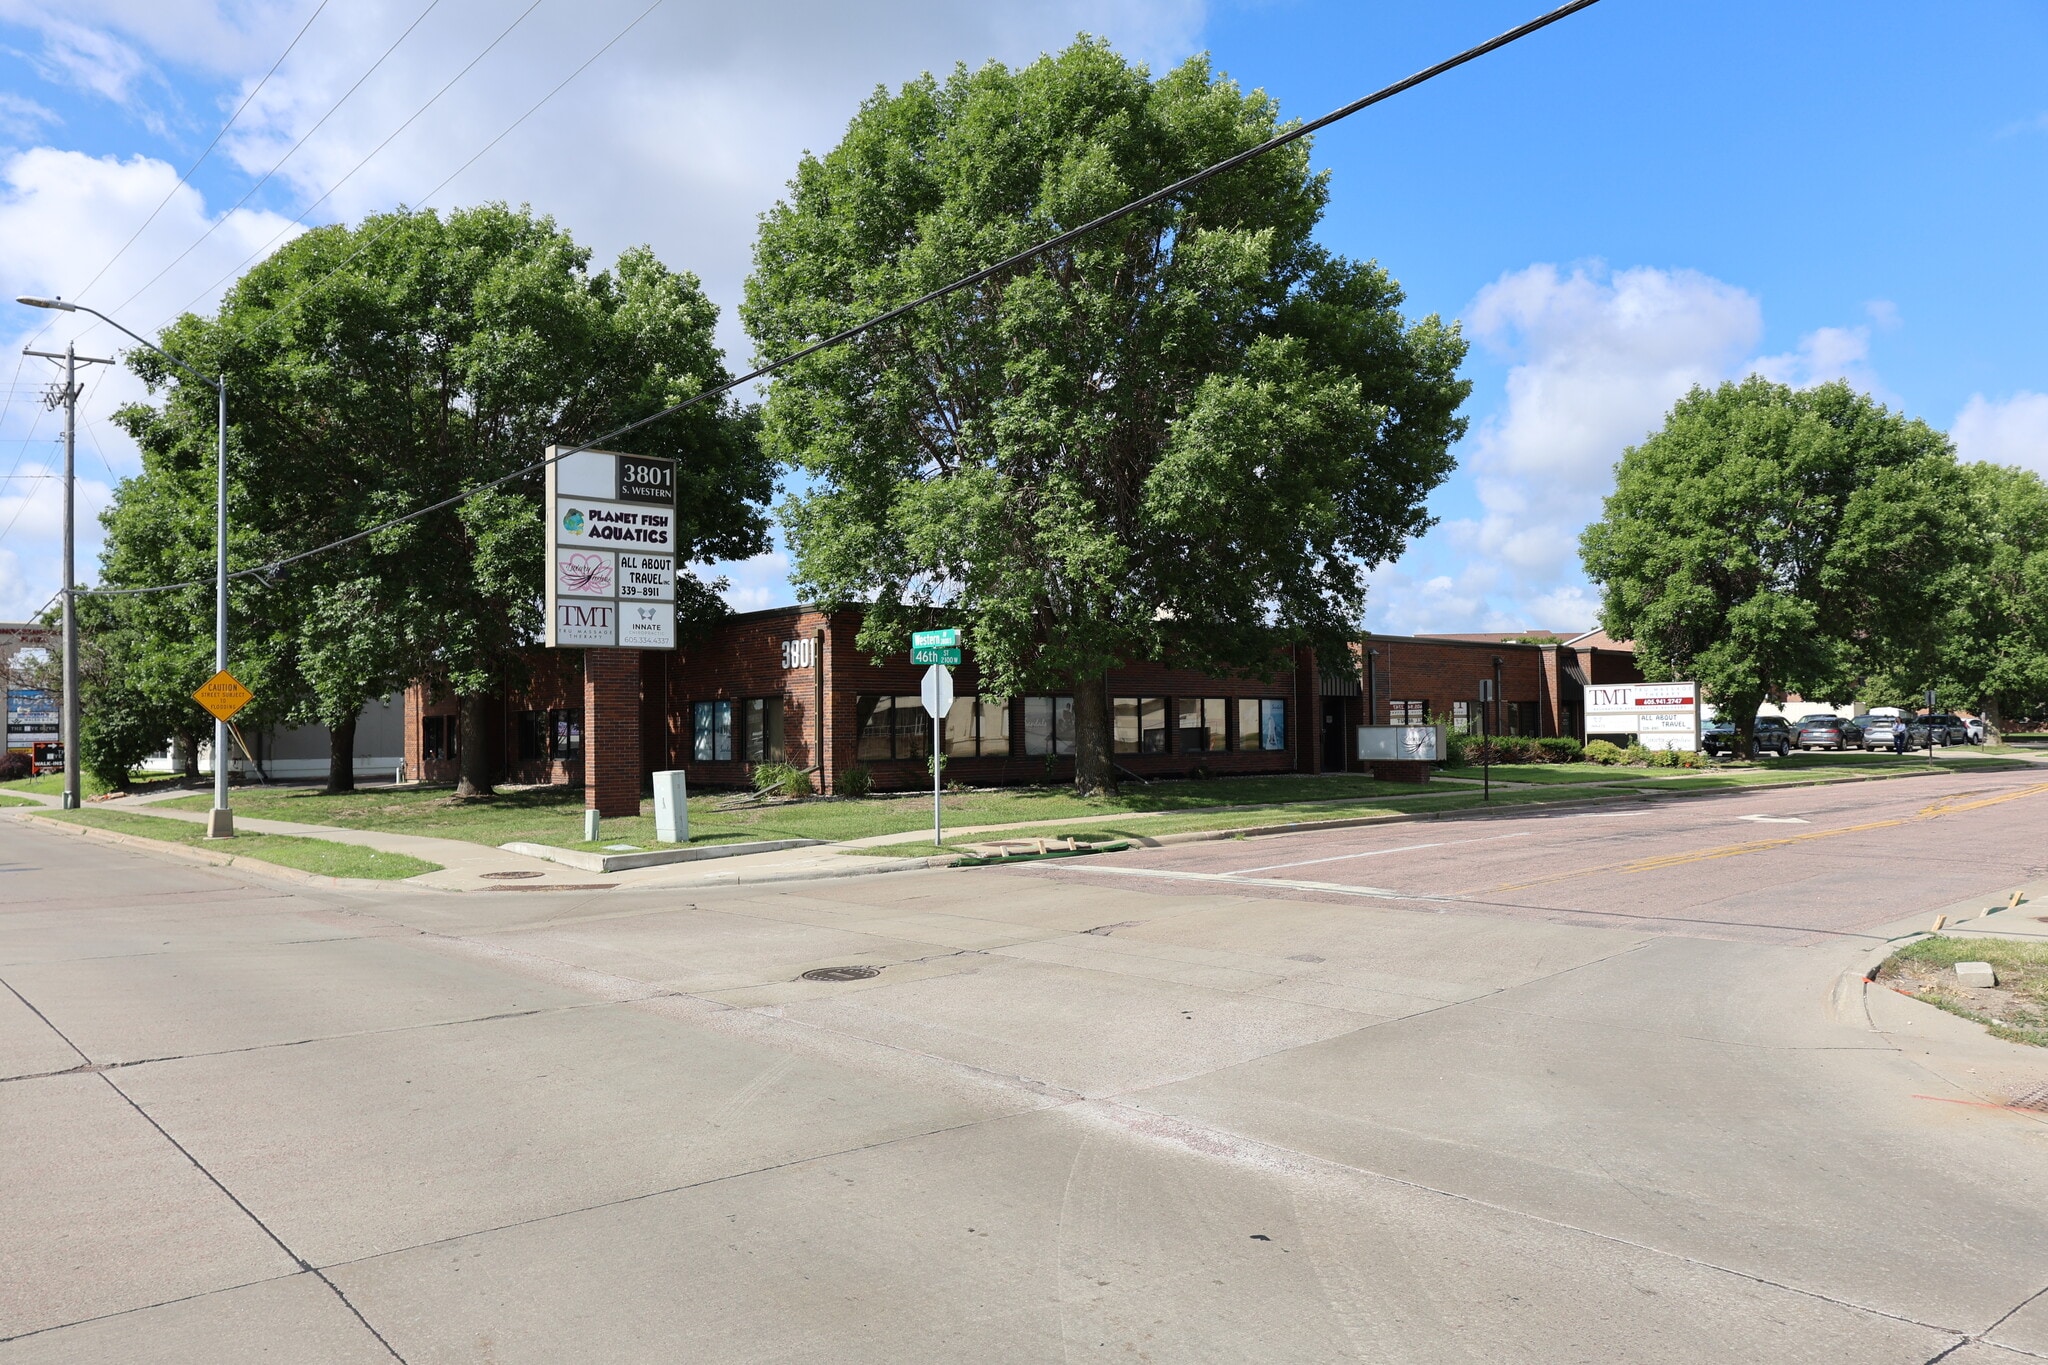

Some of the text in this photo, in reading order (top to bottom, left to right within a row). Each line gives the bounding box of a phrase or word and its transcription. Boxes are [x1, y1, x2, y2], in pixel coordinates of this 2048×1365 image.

[624, 464, 670, 486] 3801
[622, 485, 672, 498] S. WESTERN
[589, 509, 669, 527] PLANET FISH
[588, 524, 668, 544] AQUATICS
[621, 556, 671, 570] ALL ABOUT
[630, 571, 662, 585] TRAVEL
[621, 586, 659, 596] 339-8911
[558, 604, 613, 628] TMT
[632, 623, 662, 631] INNATE
[624, 636, 670, 645] 605.334.4337
[914, 633, 941, 646] Western
[781, 637, 816, 669] 3801
[915, 650, 939, 663] 46th
[208, 683, 238, 691] CAUTION
[1589, 688, 1632, 706] TMT
